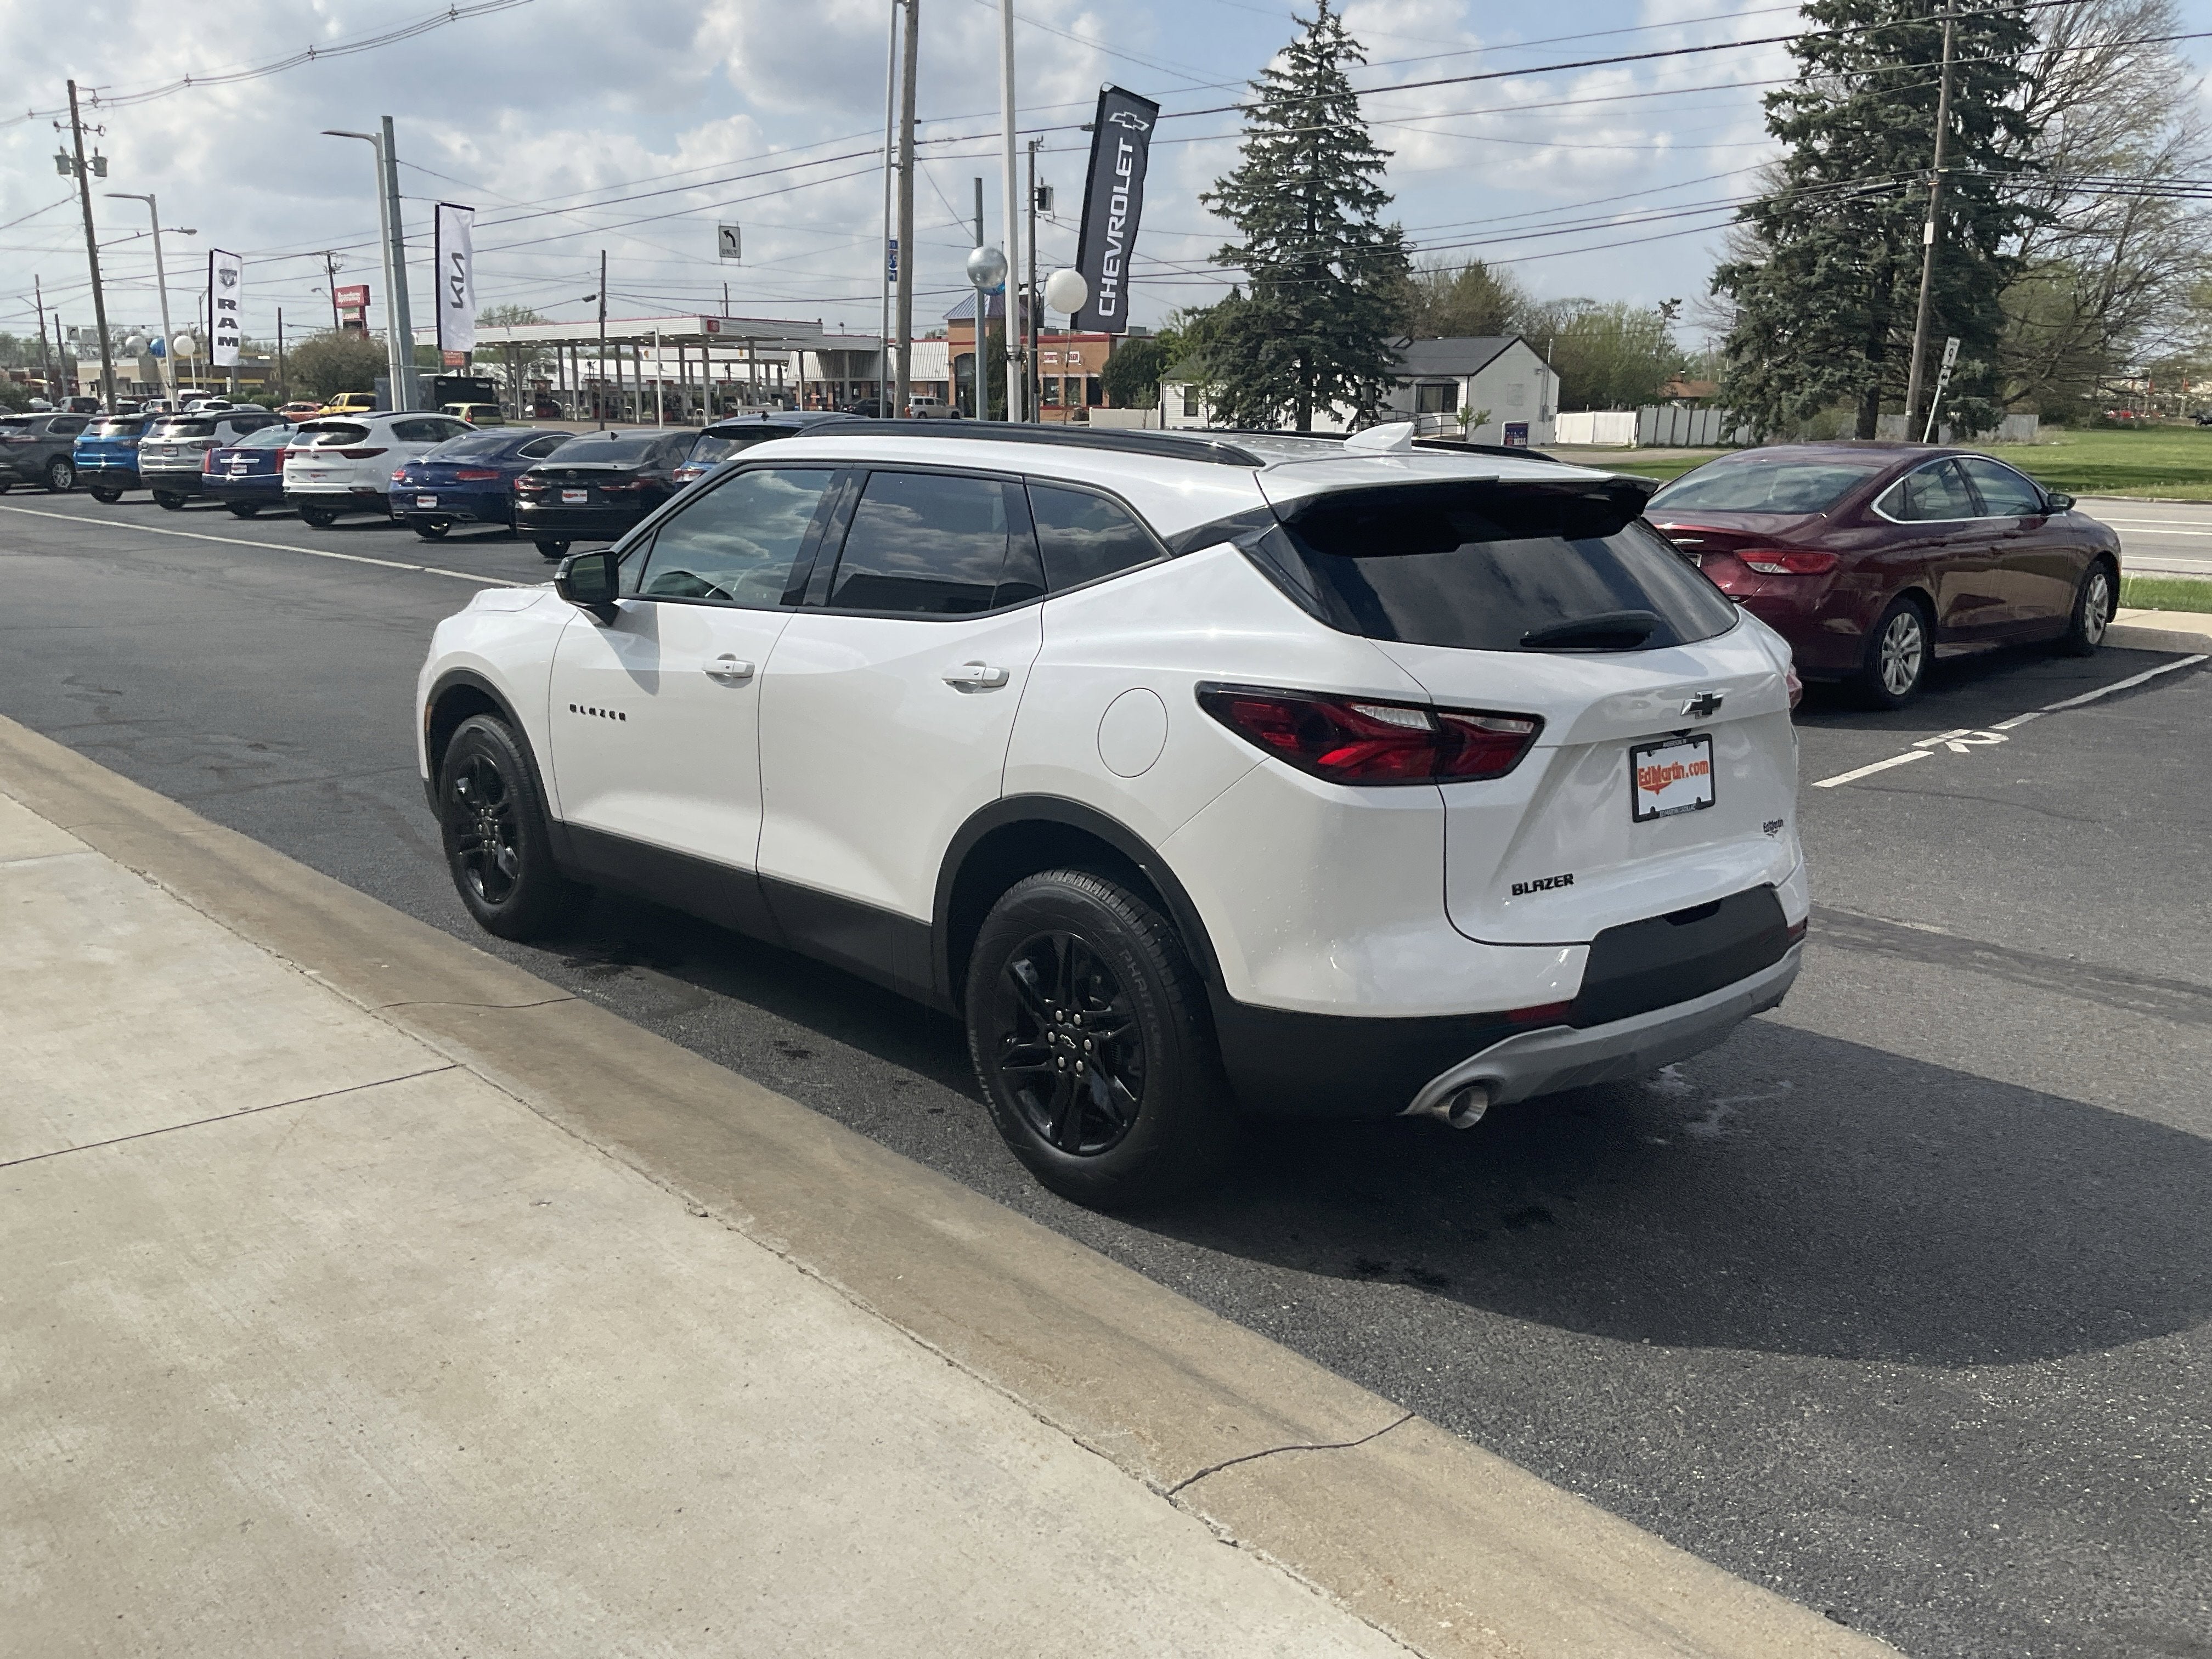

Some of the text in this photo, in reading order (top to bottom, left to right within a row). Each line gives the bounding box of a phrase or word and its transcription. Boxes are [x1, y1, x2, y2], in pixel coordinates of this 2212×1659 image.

[1098, 137, 1133, 317] CHEVROLET
[450, 252, 465, 308] KIA
[217, 298, 239, 347] RAM
[569, 703, 626, 722] BLAZER
[1638, 760, 1709, 786] EdMartin.com
[1511, 873, 1574, 896] BLAZER
